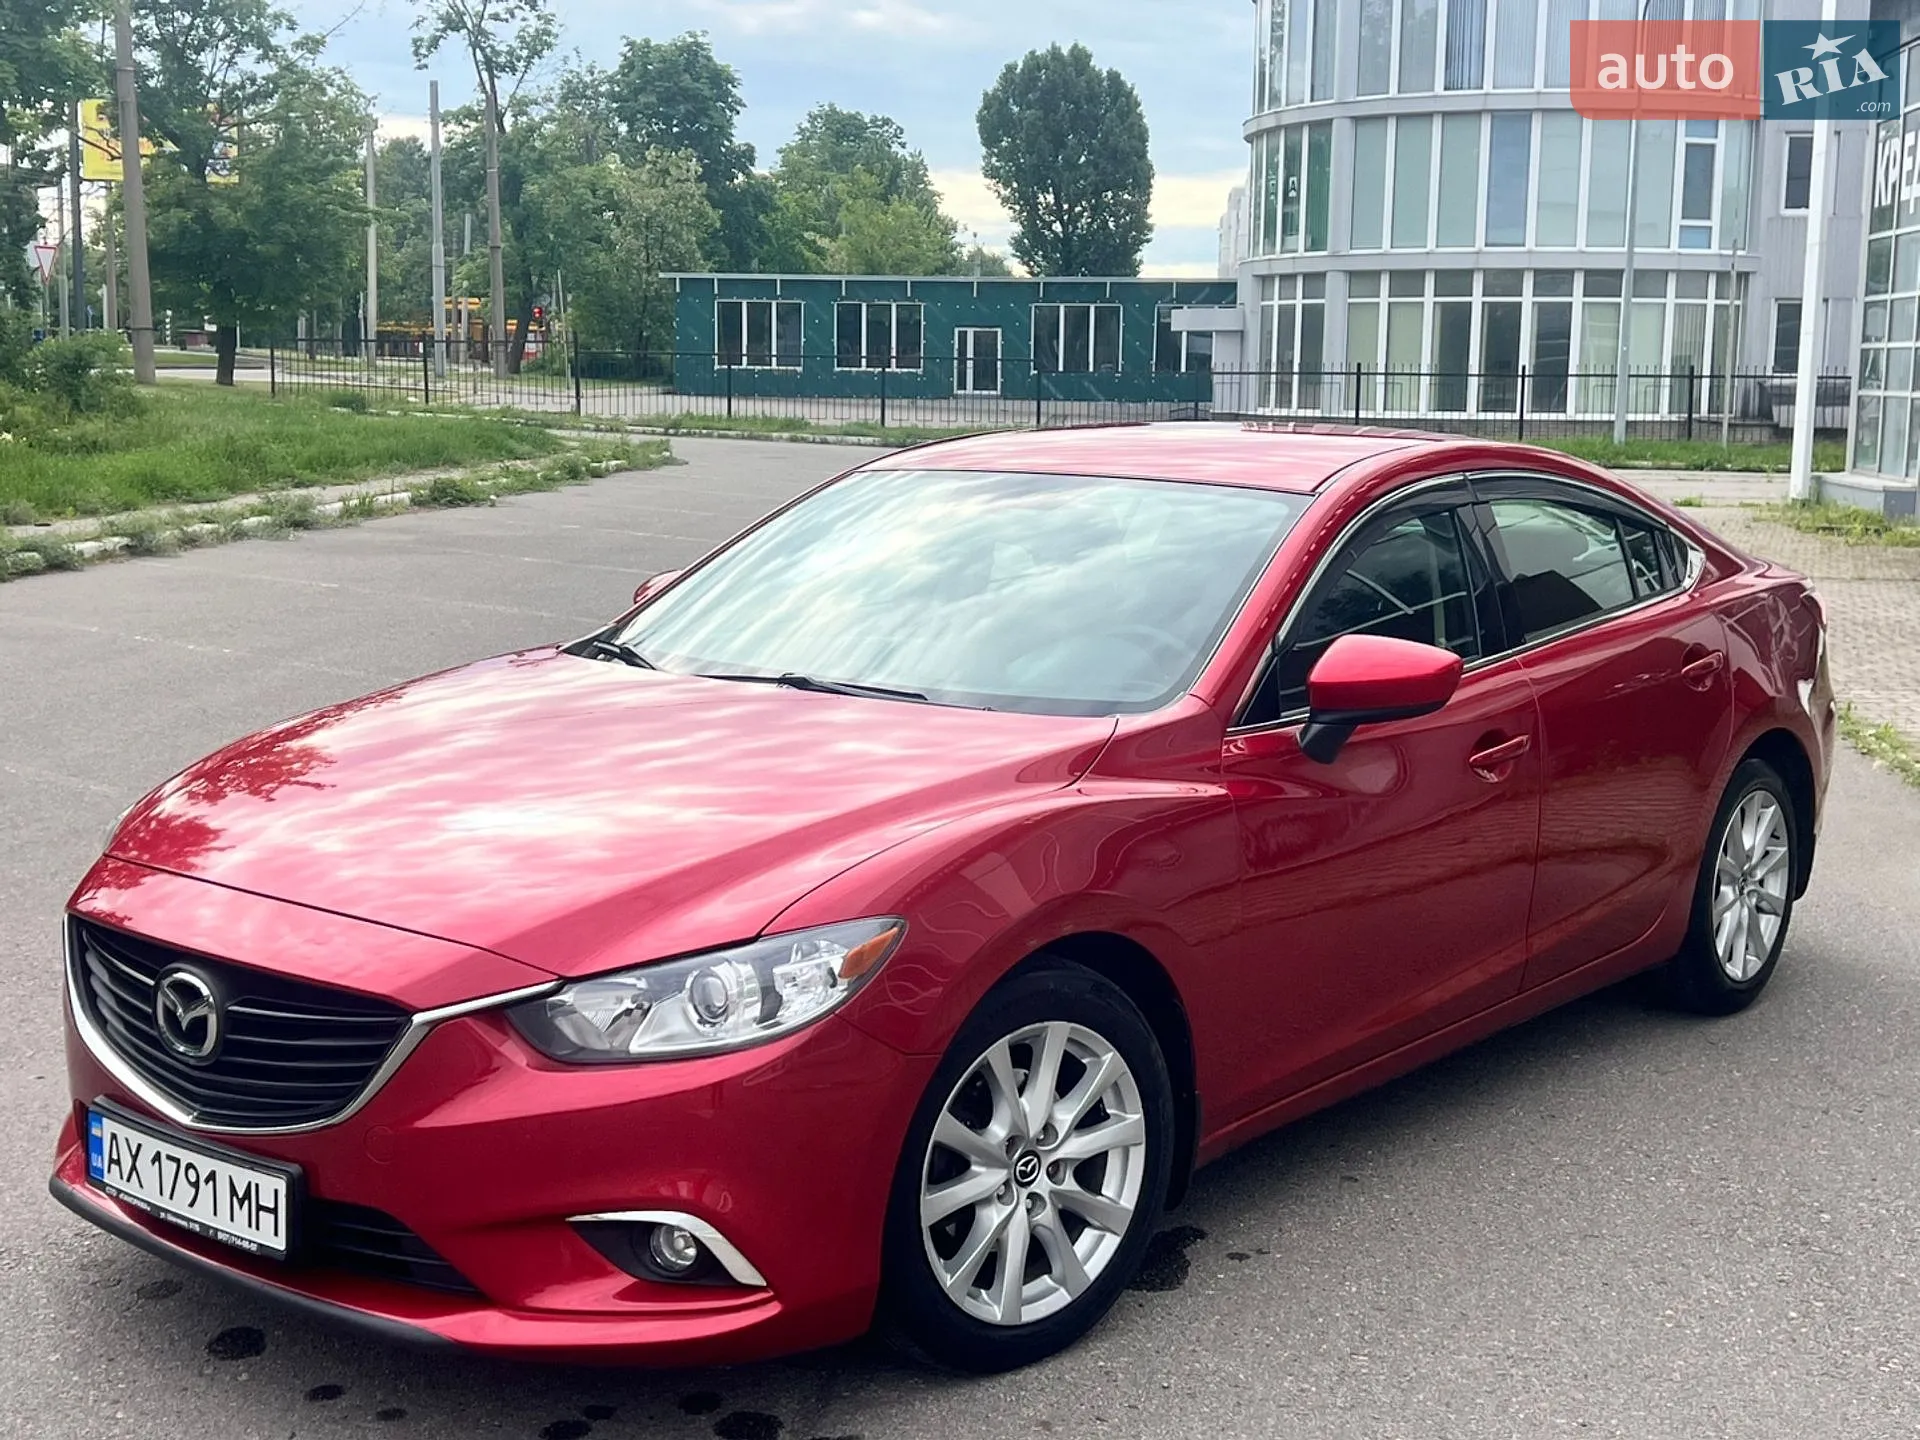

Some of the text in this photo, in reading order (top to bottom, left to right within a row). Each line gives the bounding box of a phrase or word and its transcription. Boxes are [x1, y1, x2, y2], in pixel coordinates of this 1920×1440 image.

[106, 1131, 144, 1189] AX
[150, 1150, 218, 1217] 1791
[228, 1174, 279, 1237] MH
